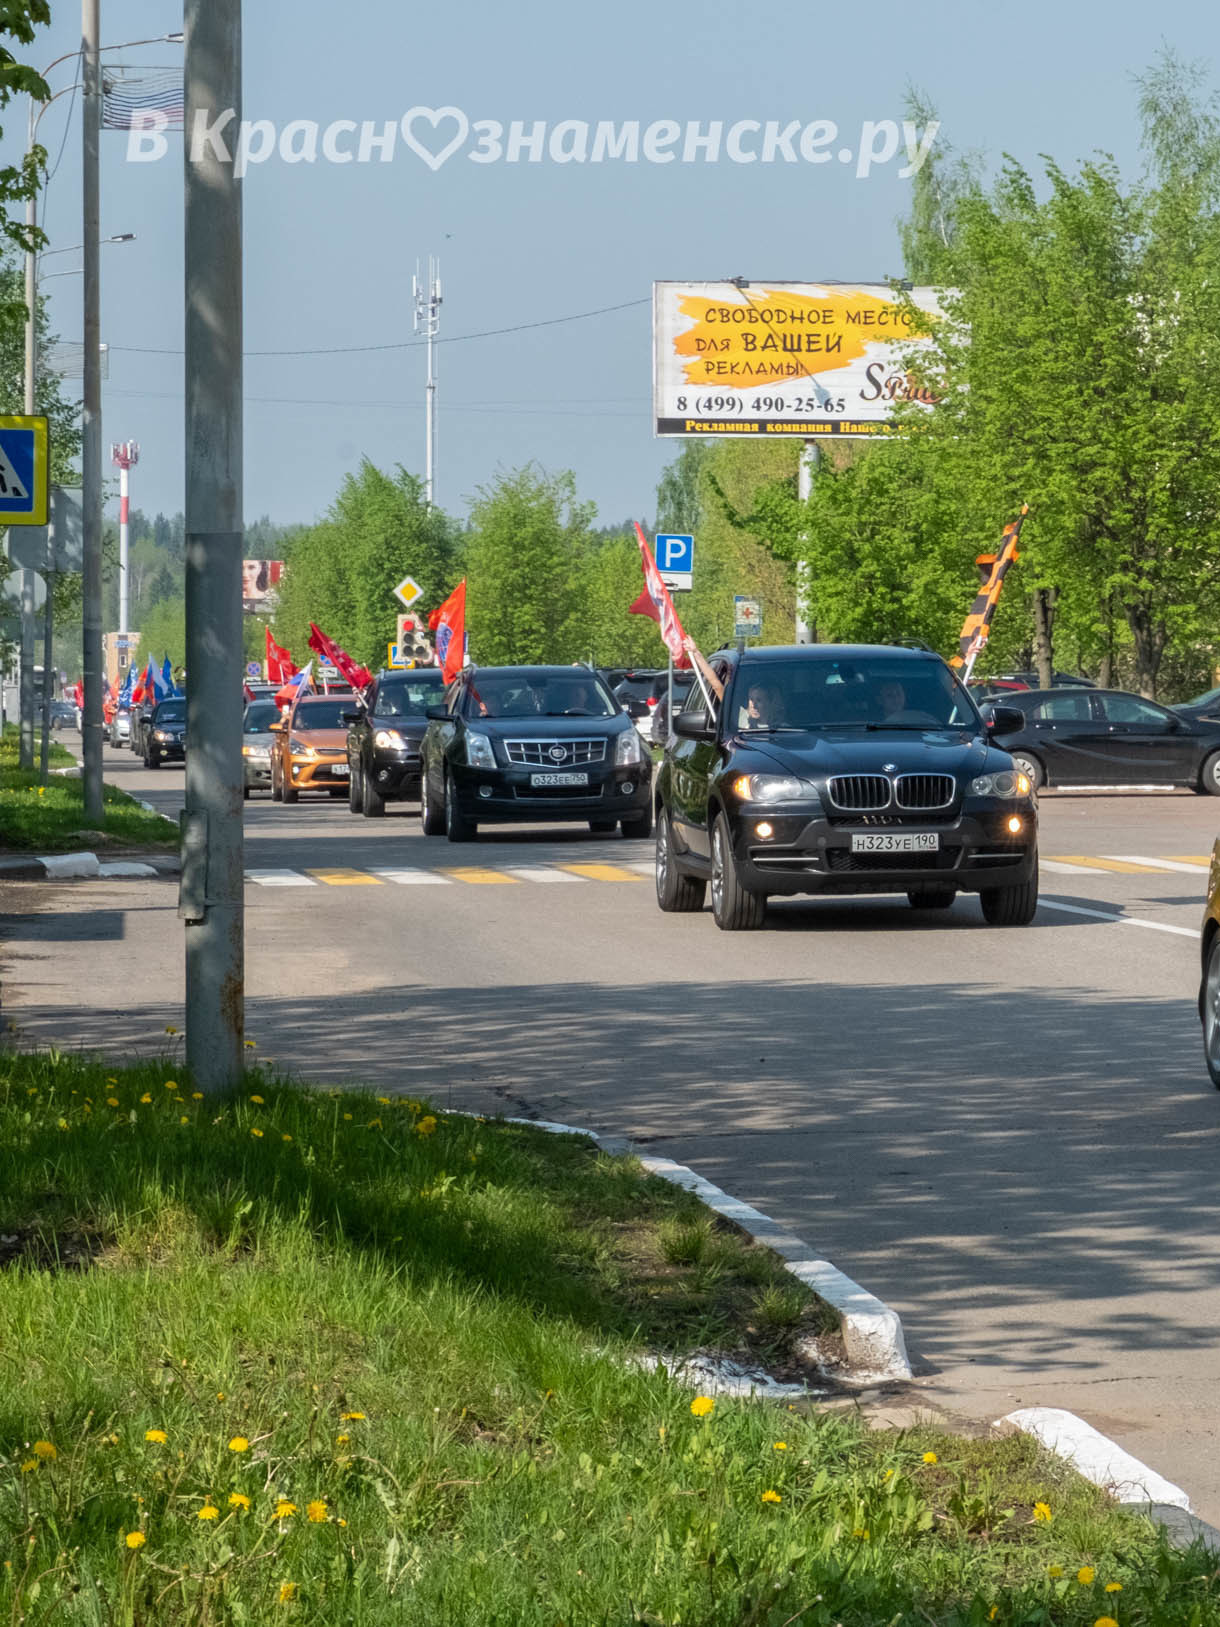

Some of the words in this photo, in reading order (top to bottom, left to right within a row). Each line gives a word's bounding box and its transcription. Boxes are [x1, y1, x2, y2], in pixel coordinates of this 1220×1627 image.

[705, 308, 835, 325] СВОБОДНОЕ
[846, 310, 912, 326] МЕСТО
[741, 332, 843, 353] ВАШЕЙ
[677, 396, 688, 411] 8
[695, 396, 744, 414] (499)
[751, 396, 846, 413] 490-25-65
[685, 420, 759, 432] Рекламная
[766, 422, 832, 432] компания
[665, 539, 687, 568] P
[915, 834, 936, 846] 190
